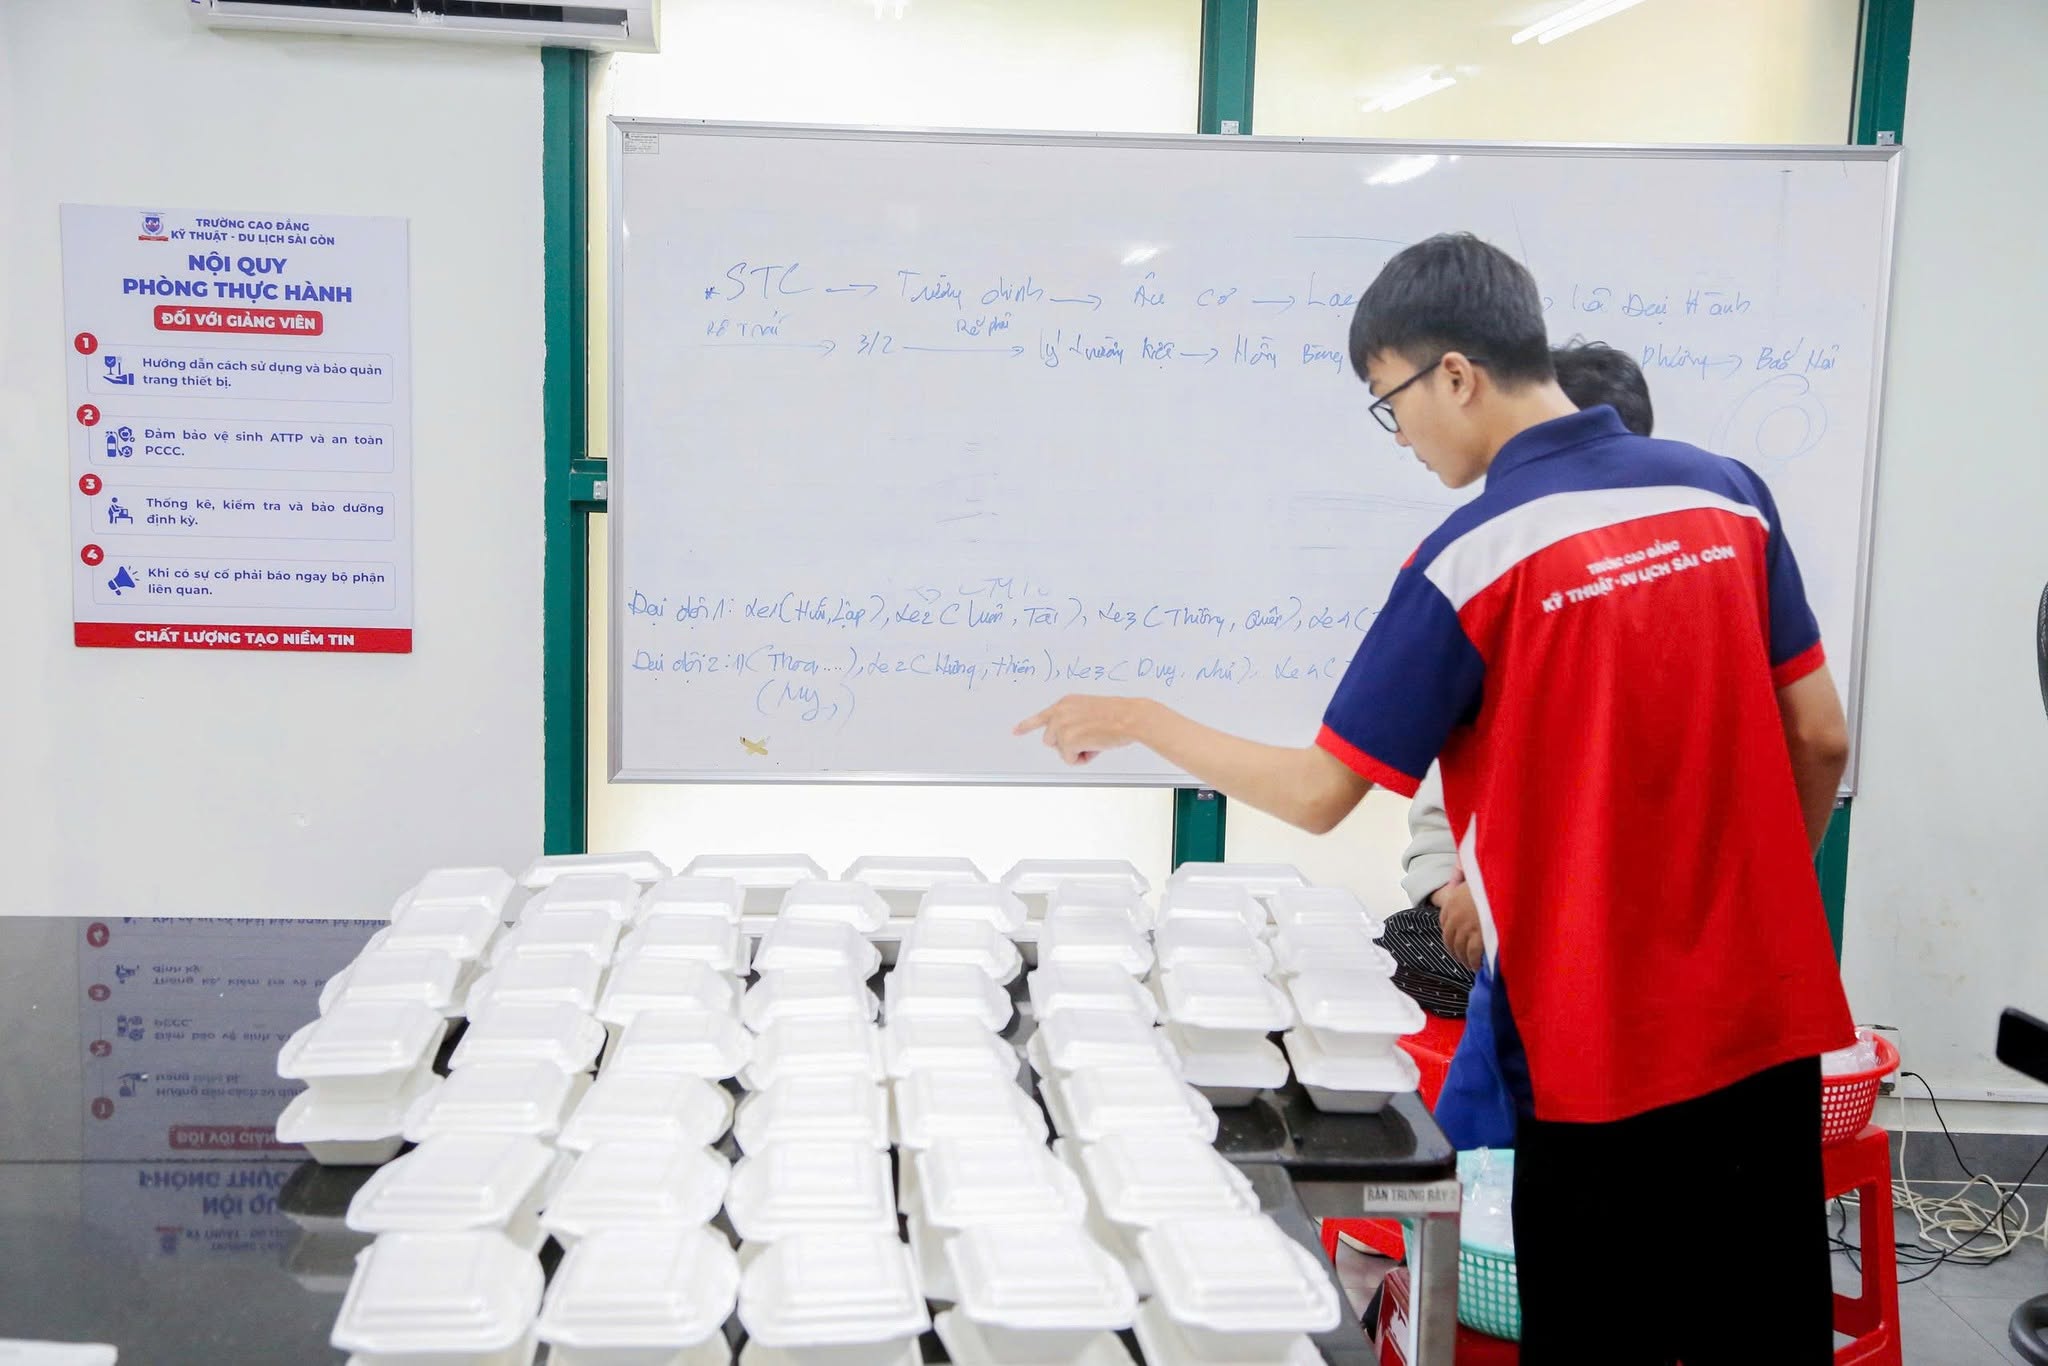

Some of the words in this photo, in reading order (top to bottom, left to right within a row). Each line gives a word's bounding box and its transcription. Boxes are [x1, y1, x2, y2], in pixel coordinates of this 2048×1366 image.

[196, 218, 245, 230] TRƯỜNG
[248, 221, 274, 231] CAO
[277, 218, 310, 232] ĐẲNG
[171, 230, 187, 241] KỸ
[189, 231, 228, 242] THUẬT
[238, 234, 254, 242] DU
[257, 234, 284, 245] LỊCH
[288, 233, 306, 244] SÀI
[310, 234, 335, 245] GÒN
[189, 251, 230, 276] NỘI
[238, 257, 287, 276] QUY
[123, 275, 208, 298] PHÒNG
[214, 281, 279, 304] THỰC
[285, 281, 352, 302] HÀNH
[162, 309, 190, 326] ĐỐI
[196, 311, 222, 327] VỚI
[227, 311, 276, 329] GIẢNG
[281, 313, 315, 330] VIÊN
[83, 338, 89, 348] 1
[858, 330, 895, 356] 3/2
[143, 358, 185, 372] Hướng
[189, 357, 213, 370] dẫn
[216, 359, 247, 371] cách
[250, 360, 266, 371] sử
[269, 362, 302, 376] dụng
[306, 363, 320, 373] và
[323, 363, 347, 374] bảo
[350, 363, 382, 377] quản
[143, 376, 178, 388] trang
[181, 375, 212, 386] thiết
[216, 375, 232, 389] bị.
[84, 410, 93, 420] 2
[144, 429, 175, 439] Đảm
[183, 430, 207, 441] bảo
[213, 430, 229, 442] vệ
[236, 431, 263, 442] sinh
[270, 433, 303, 443] ATTP
[310, 433, 325, 443] và
[331, 436, 347, 444] an
[354, 434, 383, 445] toàn
[145, 445, 184, 456] PCCC.
[86, 479, 95, 489] 3
[147, 498, 188, 511] Thống
[196, 498, 215, 511] kê,
[223, 499, 255, 510] kiểm
[263, 502, 281, 511] tra
[288, 501, 303, 511] và
[311, 502, 335, 512] bảo
[343, 502, 384, 515] dưỡng
[147, 515, 176, 526] định
[180, 515, 198, 528] kỳ.
[88, 550, 97, 560] 4
[1625, 552, 1646, 565] CAO
[148, 568, 169, 578] Khi
[174, 569, 189, 578] có
[194, 569, 209, 581] sự
[214, 568, 229, 579] cố
[234, 569, 262, 583] phải
[267, 570, 291, 581] báo
[296, 572, 327, 584] ngay
[332, 571, 348, 583] bộ
[352, 571, 385, 584] phận
[1542, 591, 1565, 612] KỸ
[1639, 564, 1671, 583] LỊCH
[1671, 553, 1700, 571] SÀI
[1701, 546, 1735, 564] GÒN
[148, 584, 172, 594] liên
[176, 586, 212, 597] quan.
[134, 627, 179, 643] CHẤT
[183, 631, 241, 646] LƯỢNG
[245, 632, 280, 647] TẠO
[284, 629, 324, 646] NIỀM
[328, 634, 355, 646] TIN
